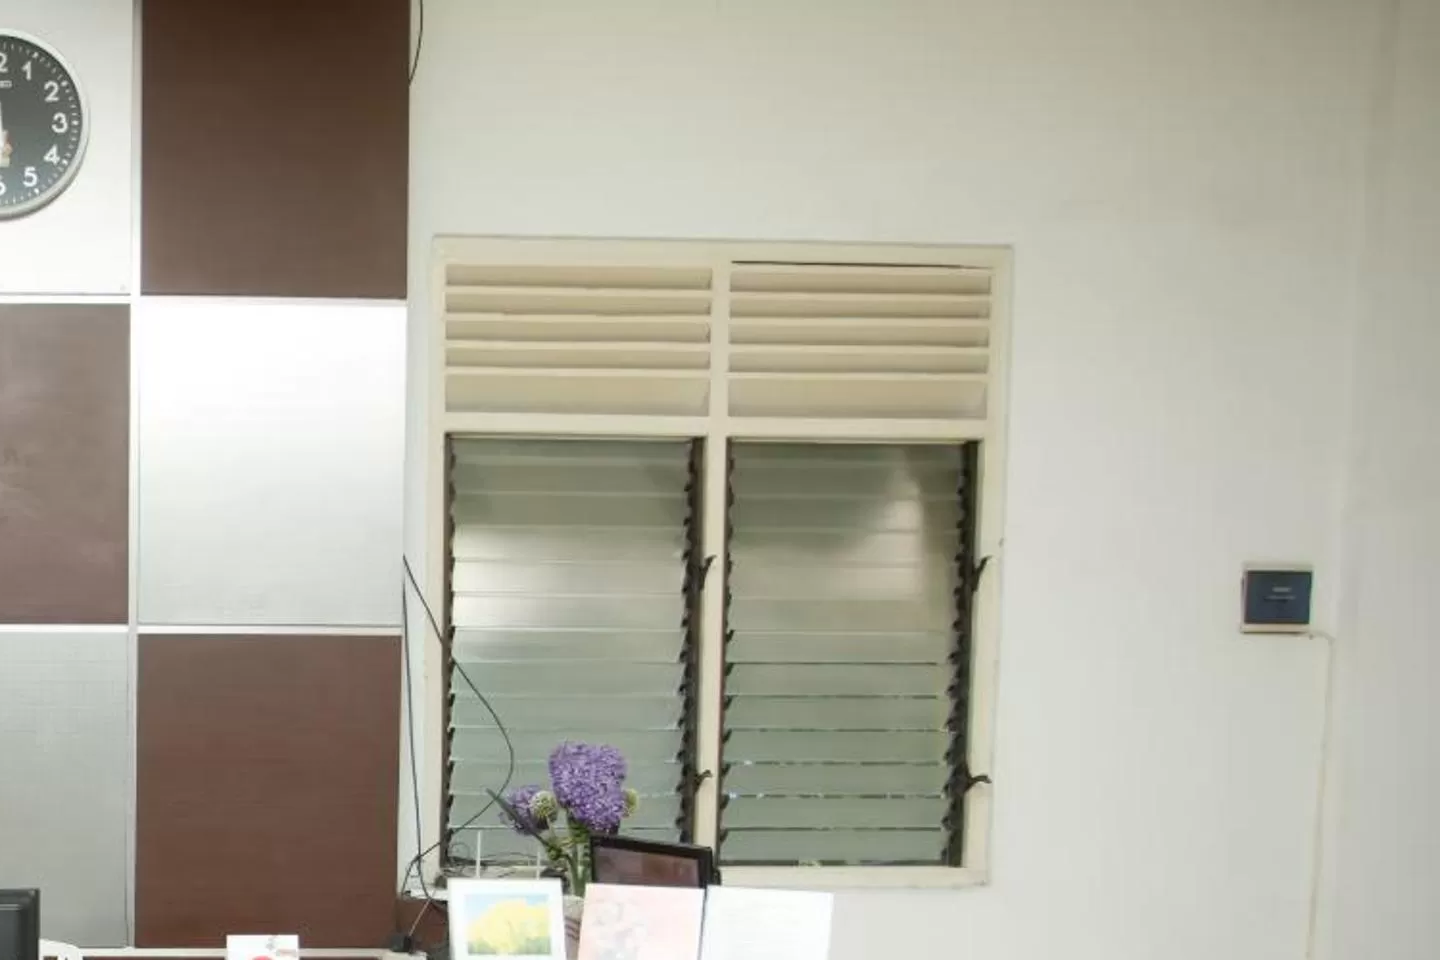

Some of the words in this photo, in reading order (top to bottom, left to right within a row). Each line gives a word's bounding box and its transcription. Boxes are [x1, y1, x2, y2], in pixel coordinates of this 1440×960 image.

[22, 60, 32, 81] 1
[44, 81, 59, 102] 2
[52, 113, 68, 133] 3
[43, 144, 61, 165] 4
[23, 166, 38, 187] 5
